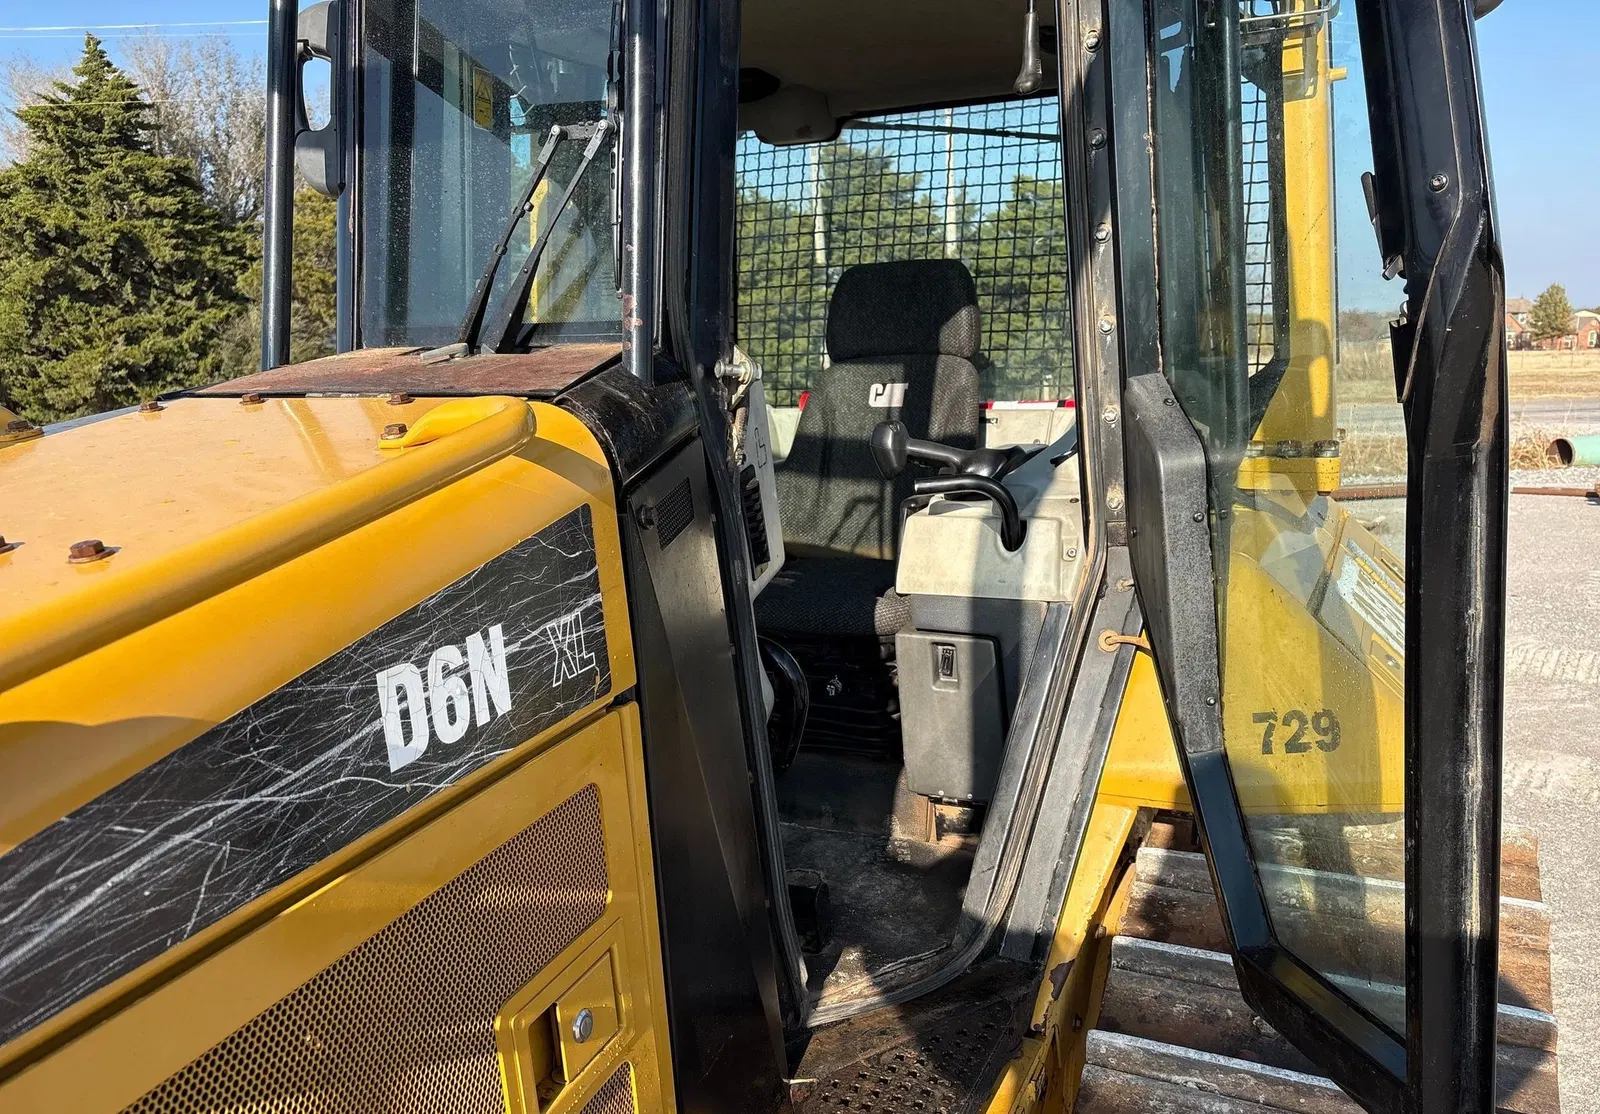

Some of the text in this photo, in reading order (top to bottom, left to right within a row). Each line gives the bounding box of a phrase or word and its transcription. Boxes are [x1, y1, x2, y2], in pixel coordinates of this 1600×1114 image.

[868, 382, 909, 407] CAT
[376, 611, 596, 773] D6N XL
[1252, 708, 1341, 755] 729
